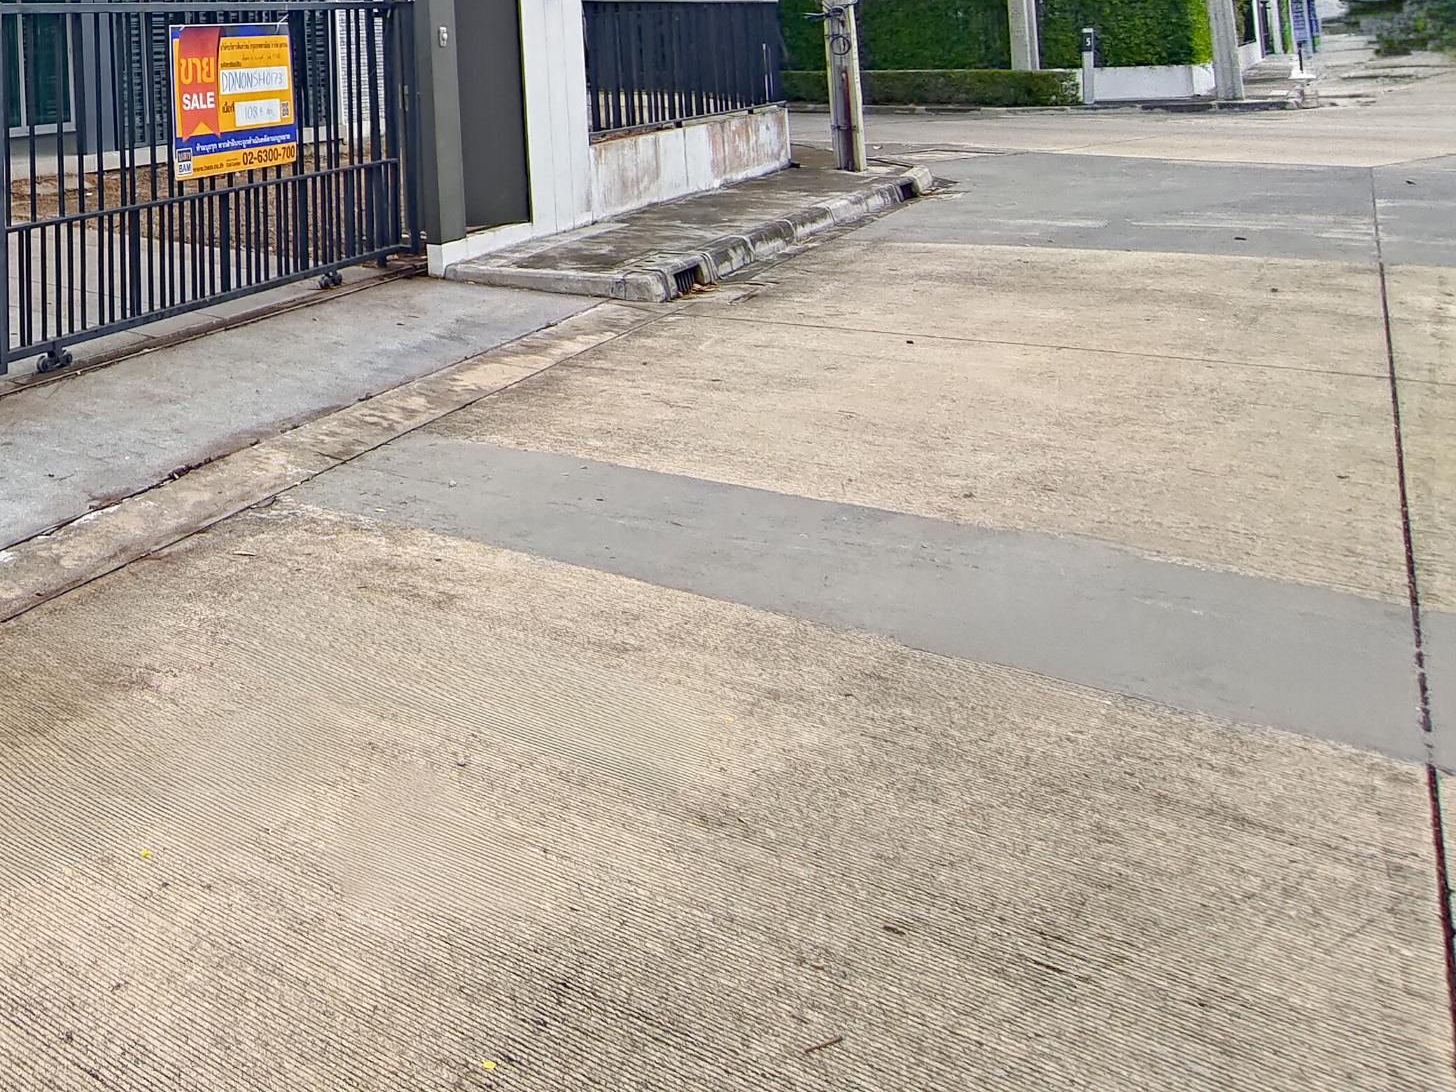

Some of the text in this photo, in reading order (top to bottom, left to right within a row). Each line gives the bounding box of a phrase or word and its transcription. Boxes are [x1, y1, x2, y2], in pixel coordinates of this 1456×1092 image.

[180, 57, 215, 84] ขาย
[182, 91, 216, 111] SALE
[242, 145, 296, 166] 02-6300-700
[178, 163, 191, 174] BAM
